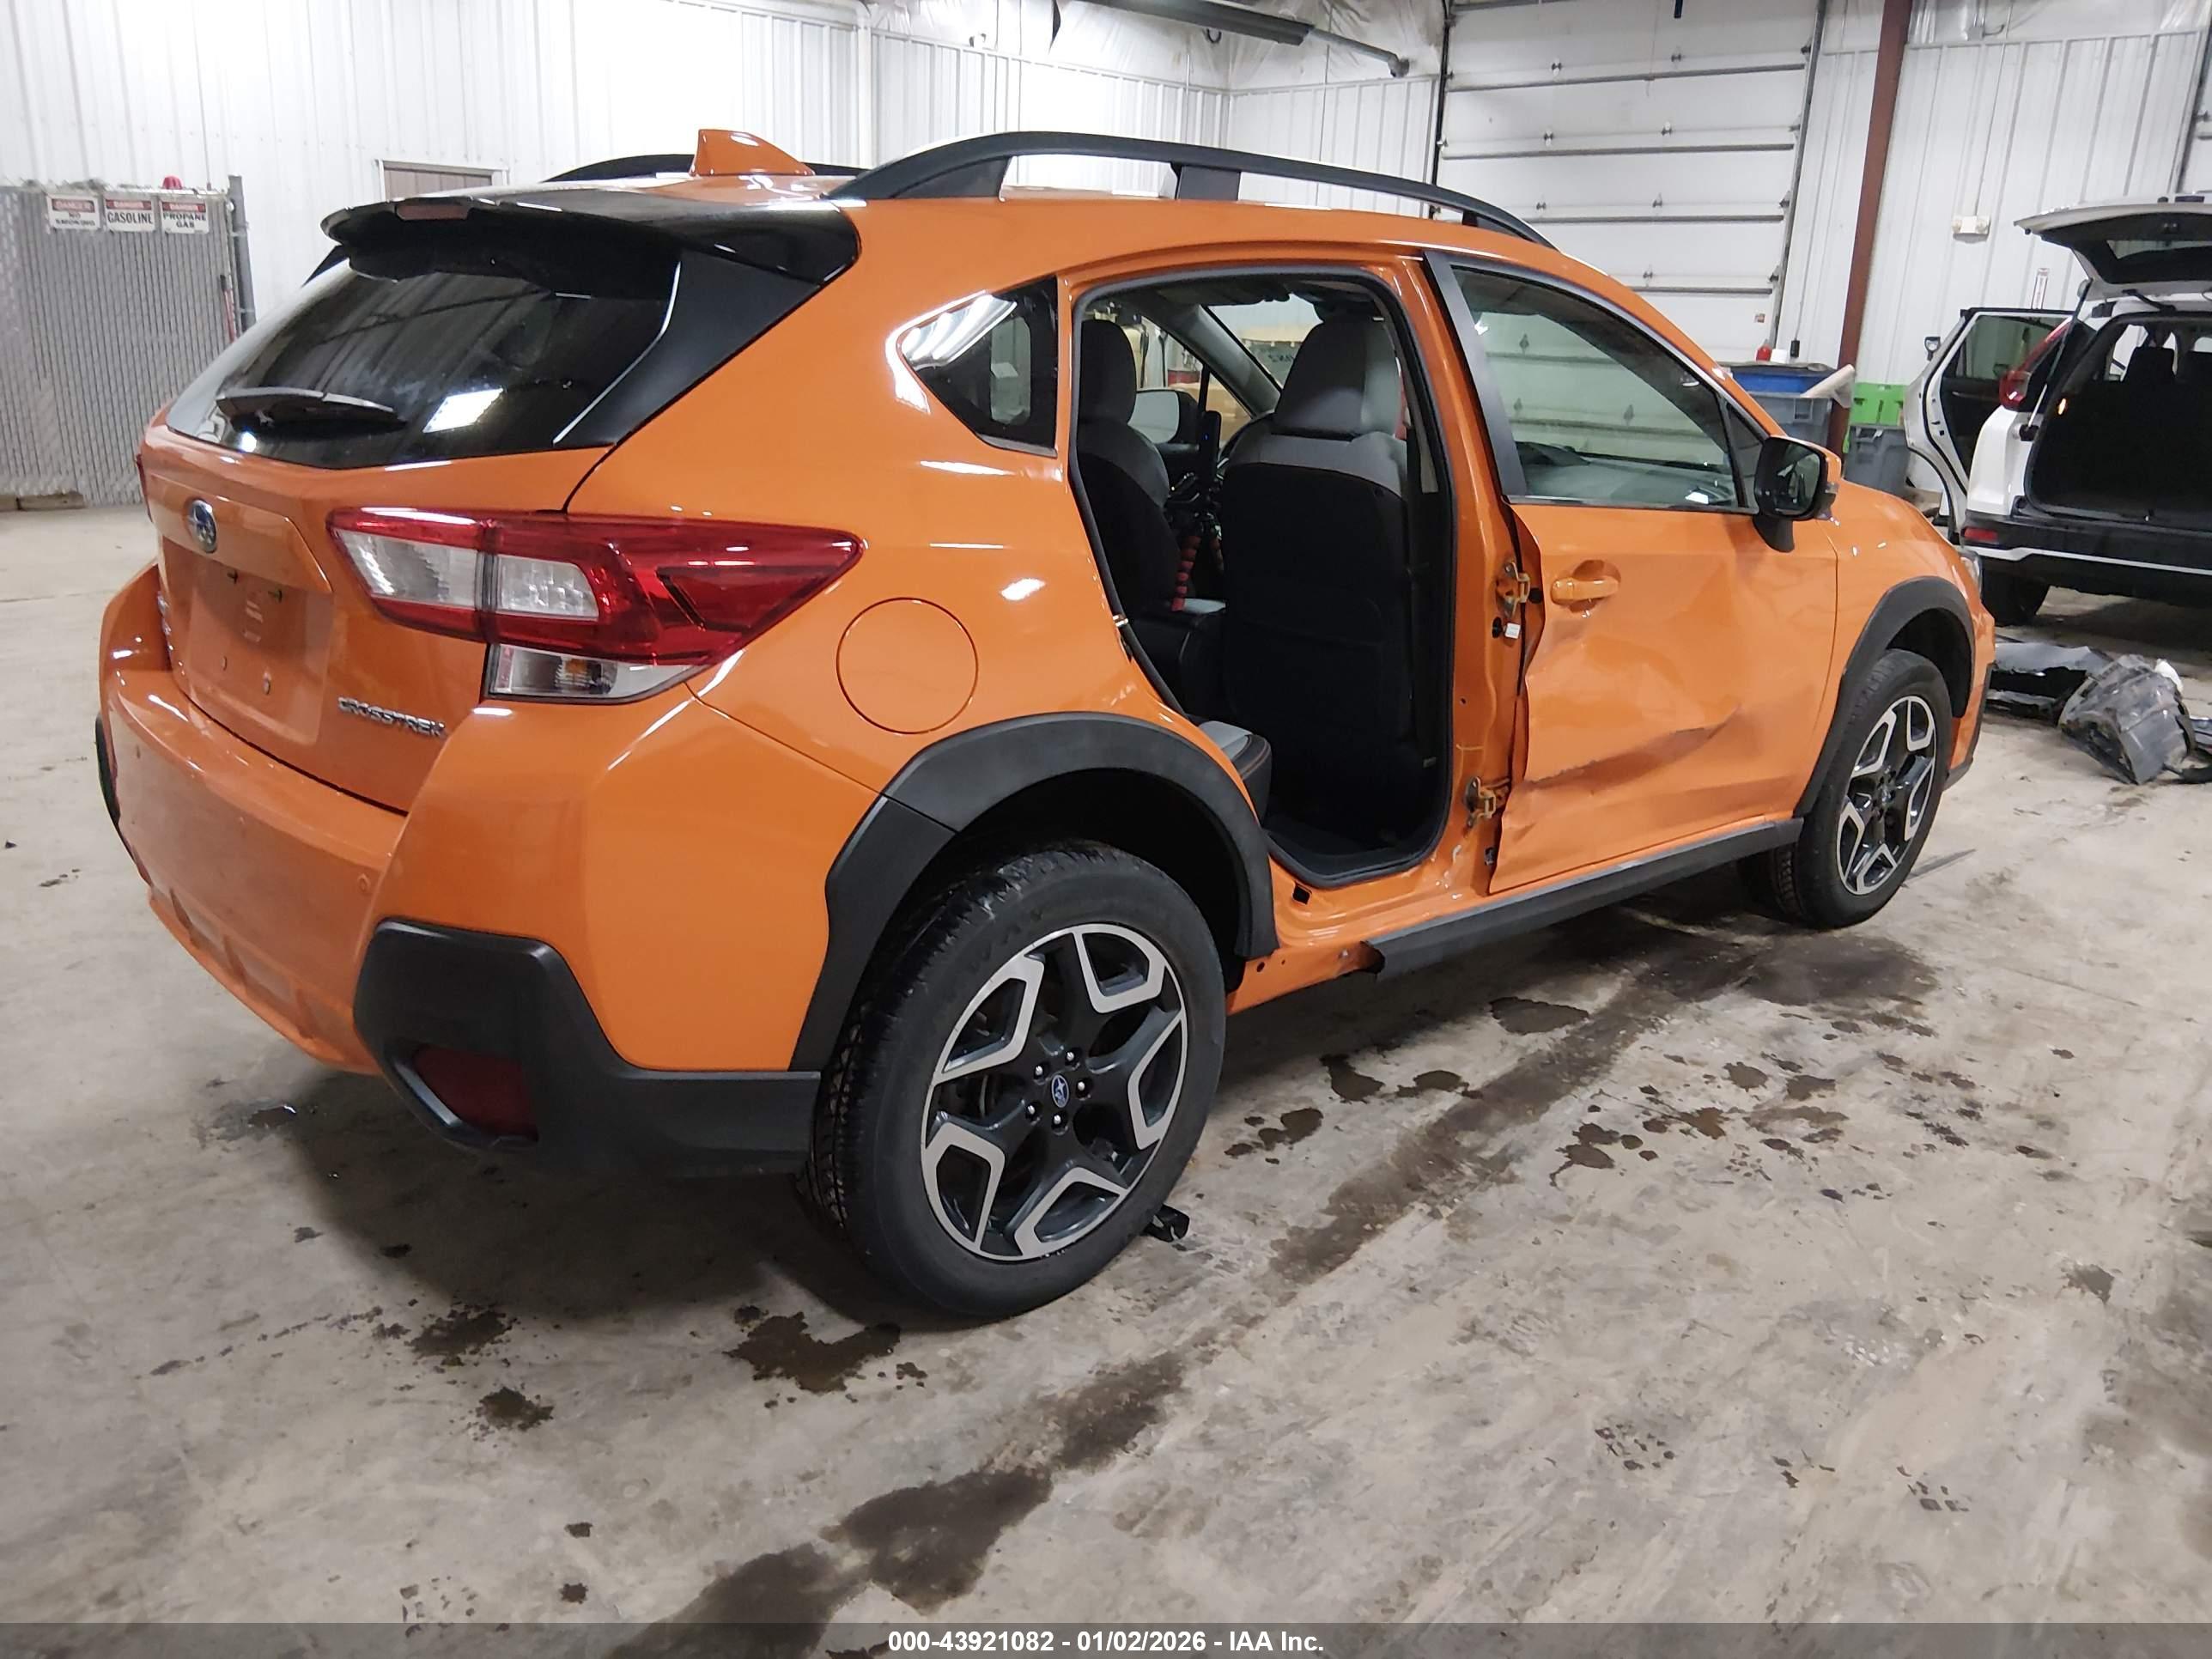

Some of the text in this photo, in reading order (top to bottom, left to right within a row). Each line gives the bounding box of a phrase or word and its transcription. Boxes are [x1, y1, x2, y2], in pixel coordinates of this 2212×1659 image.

[107, 211, 154, 224] GASOLINE
[162, 211, 207, 222] PROPANE
[175, 220, 196, 228] GAS
[337, 696, 446, 737] CROSSTREK
